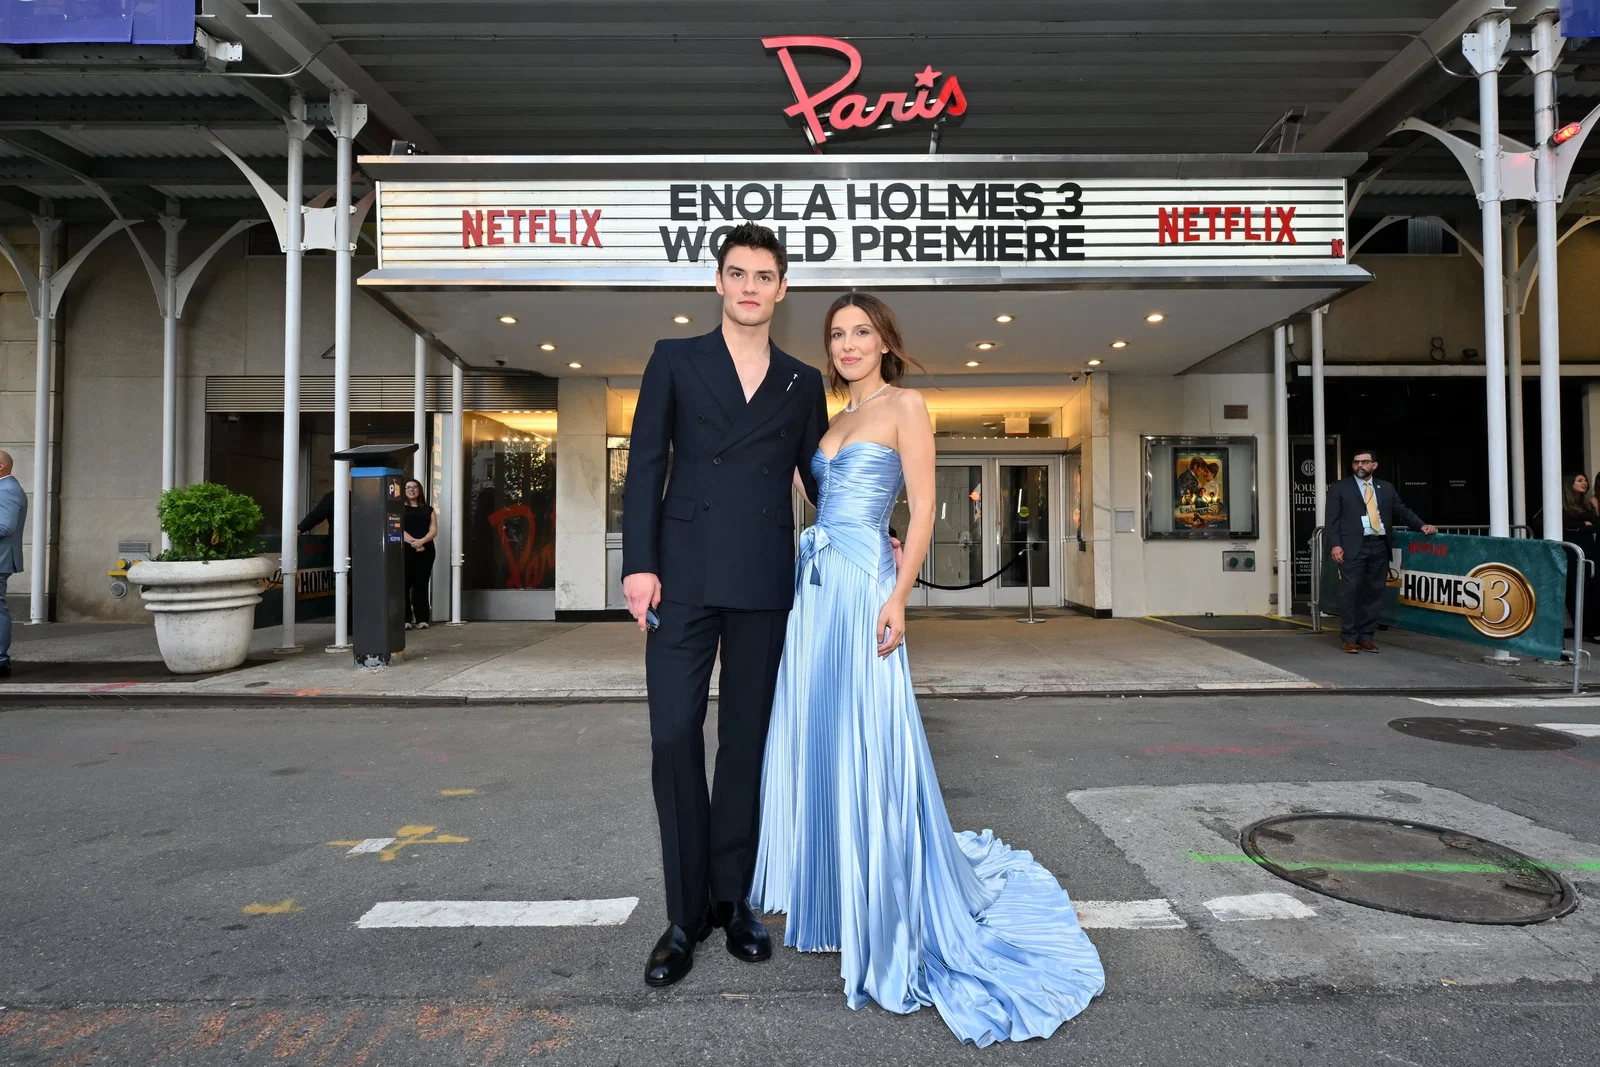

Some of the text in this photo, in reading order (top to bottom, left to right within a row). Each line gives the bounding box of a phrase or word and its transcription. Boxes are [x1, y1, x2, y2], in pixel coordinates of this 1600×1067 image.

[761, 35, 968, 144] Paris
[670, 182, 1084, 221] ENOLA HOLMES 3
[462, 209, 603, 249] NETFLIX
[659, 225, 1085, 262] WOLD PREMIERE
[1158, 206, 1297, 246] NETFLIX
[1331, 238, 1344, 258] N
[1409, 541, 1447, 557] NETFLIX
[1404, 573, 1511, 624] HOLMES 3
